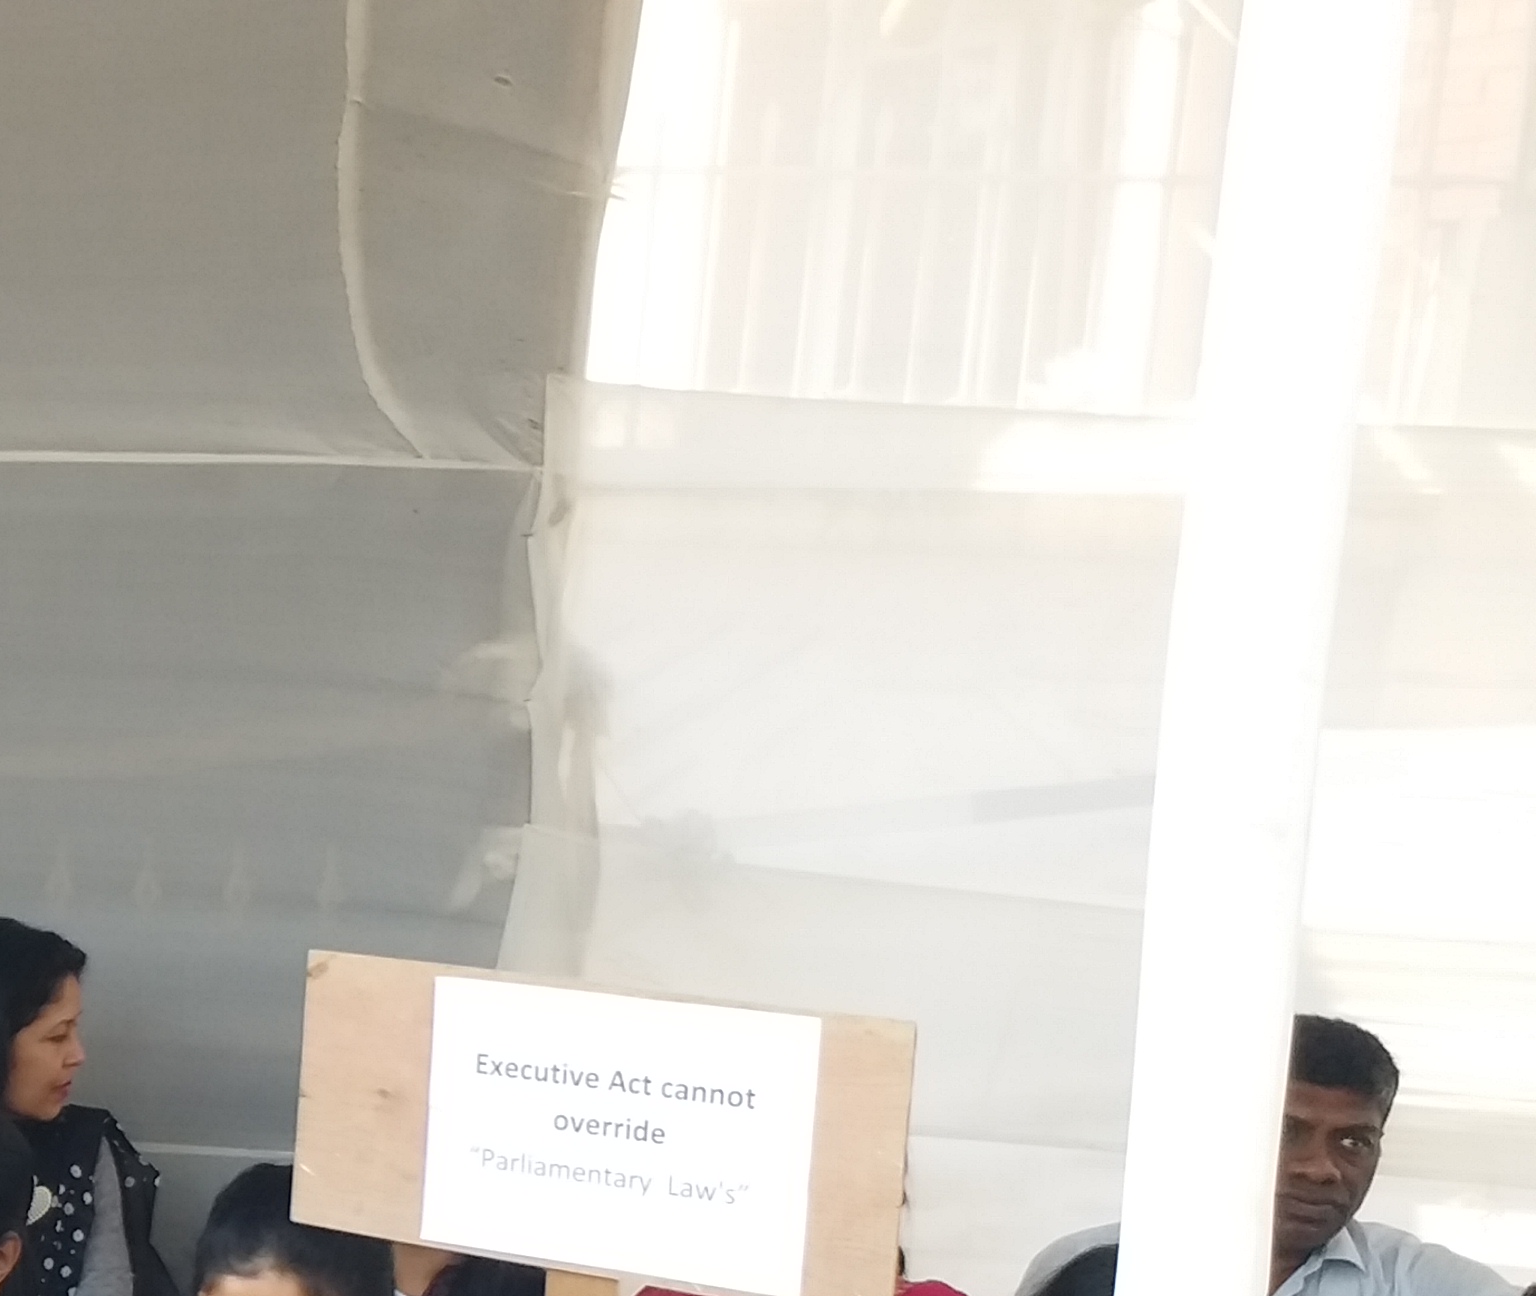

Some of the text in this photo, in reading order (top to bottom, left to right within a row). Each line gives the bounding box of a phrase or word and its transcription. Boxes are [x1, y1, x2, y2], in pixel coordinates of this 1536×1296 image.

[475, 1053, 757, 1110] Executive Act cannot
[553, 1111, 667, 1145] override
